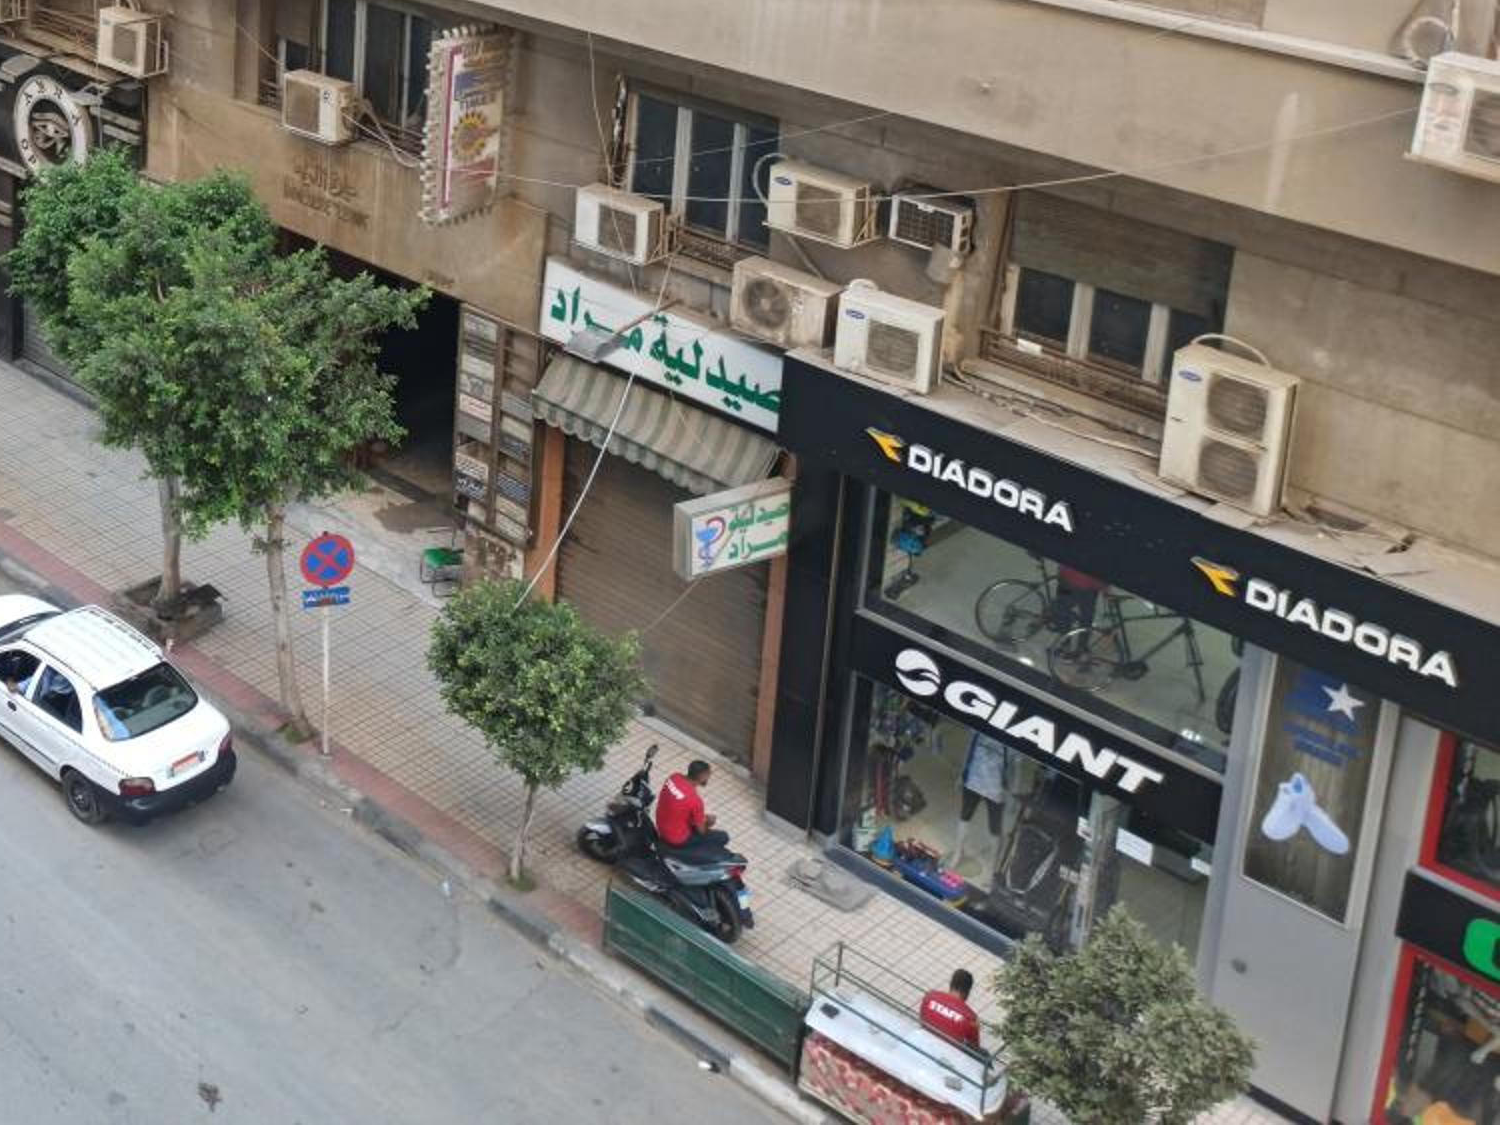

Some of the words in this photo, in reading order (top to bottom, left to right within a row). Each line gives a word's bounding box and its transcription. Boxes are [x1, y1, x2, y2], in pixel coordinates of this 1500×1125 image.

[908, 442, 1073, 533] DIADORA
[1245, 578, 1458, 688] DIADORA
[944, 680, 1166, 794] GIANT
[928, 999, 965, 1023] STAFF
